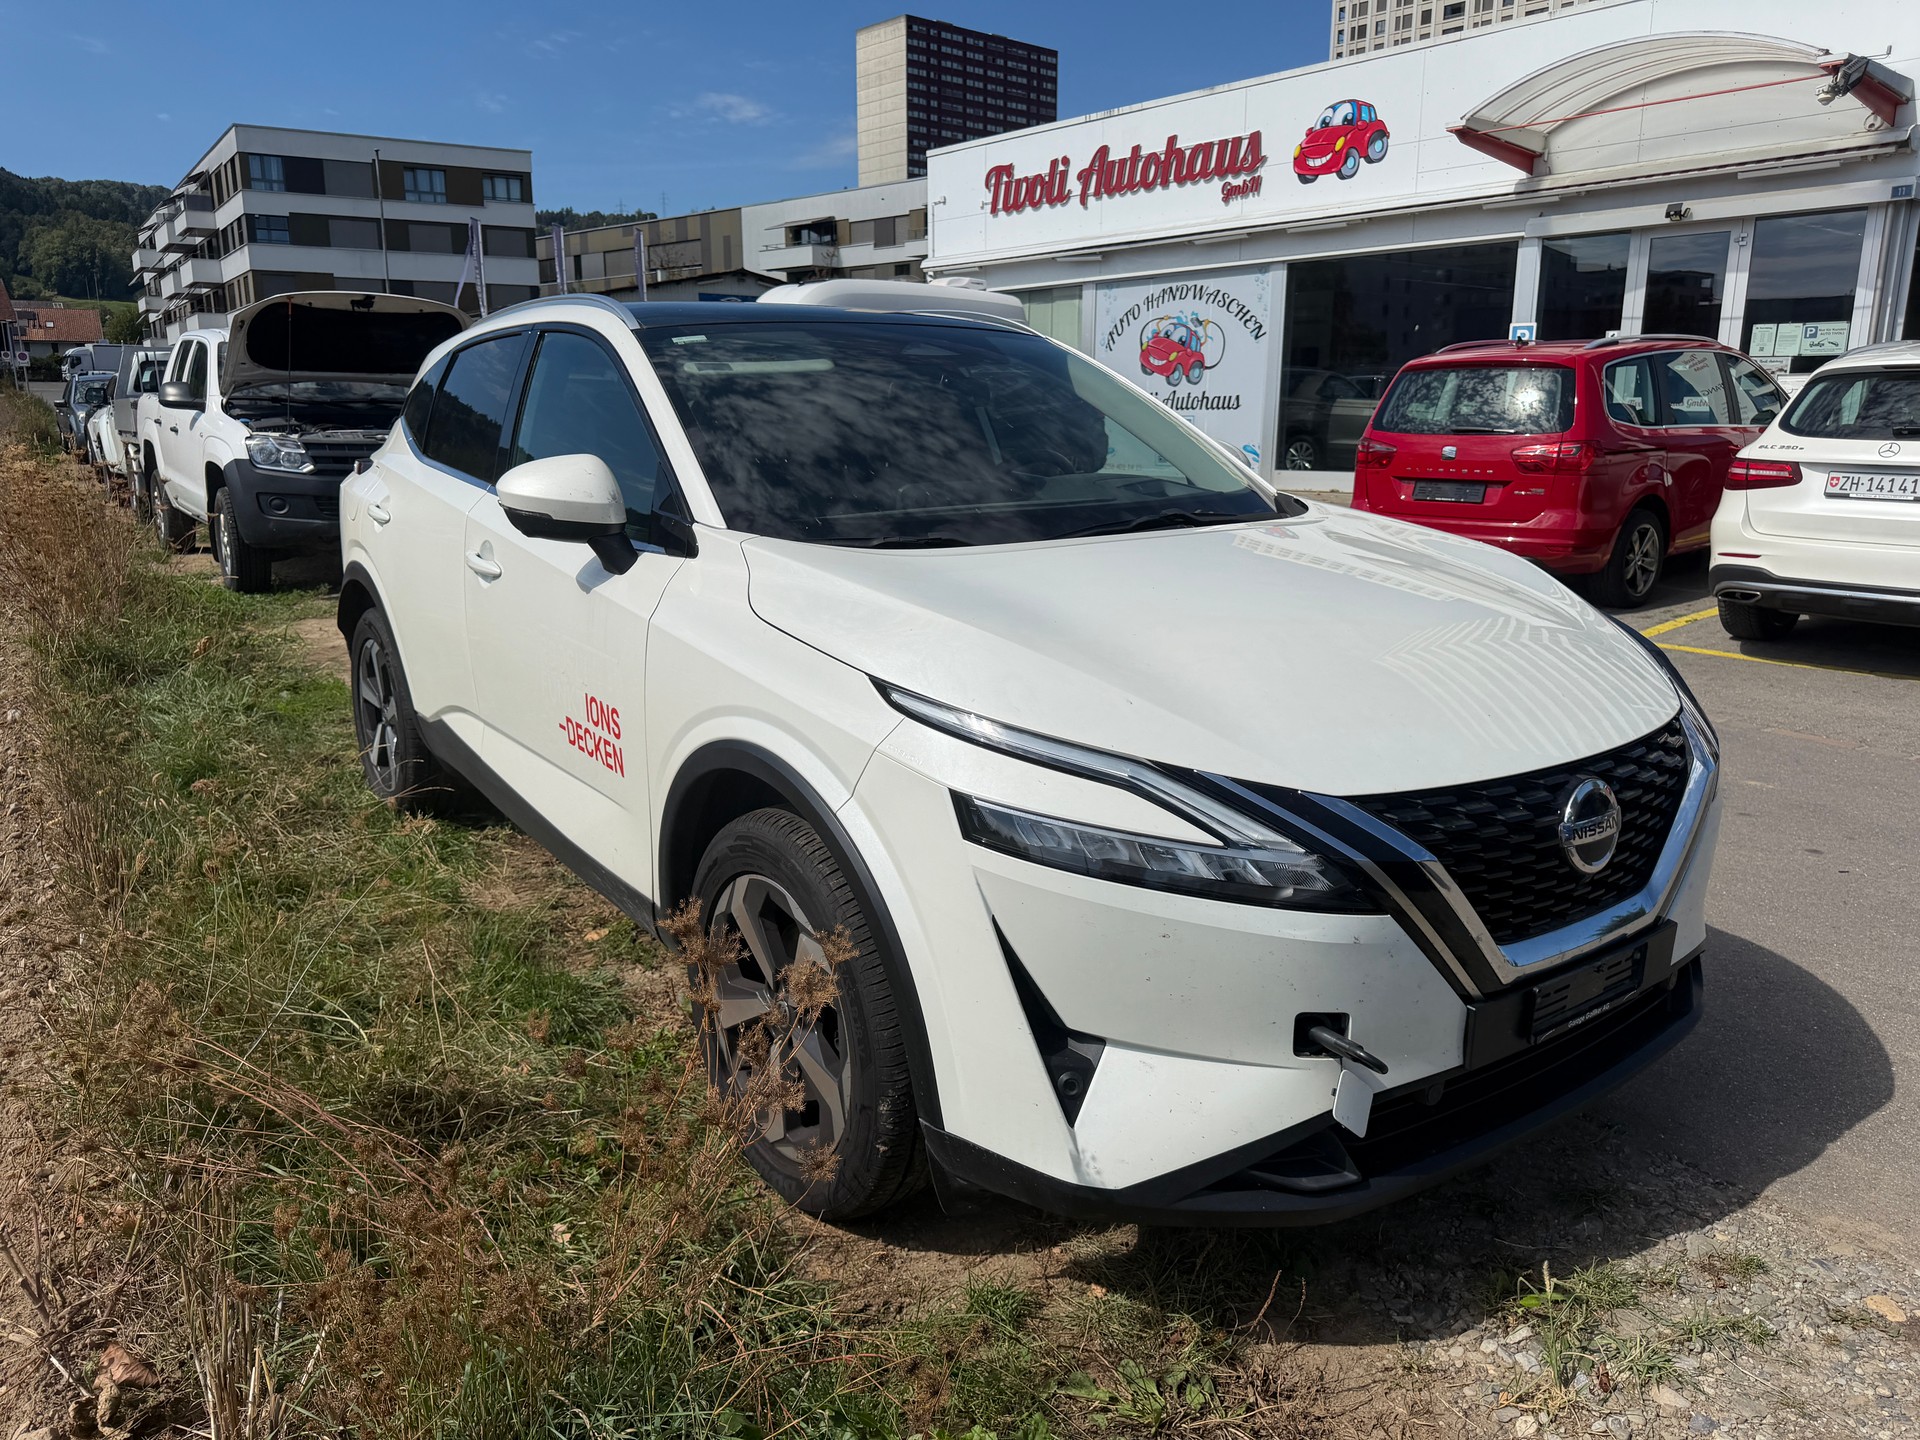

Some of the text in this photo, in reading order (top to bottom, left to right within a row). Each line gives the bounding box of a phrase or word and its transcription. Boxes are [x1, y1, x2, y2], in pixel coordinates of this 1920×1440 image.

[985, 130, 1267, 215] Tivoli Autohaus
[1221, 175, 1262, 205] GmbH
[1105, 284, 1267, 352] AUTO HANDWASCHEN
[1162, 390, 1241, 411] Autohaus
[585, 692, 621, 740] IONS
[559, 715, 625, 778] -DECKEN
[1572, 815, 1617, 841] NISSAN
